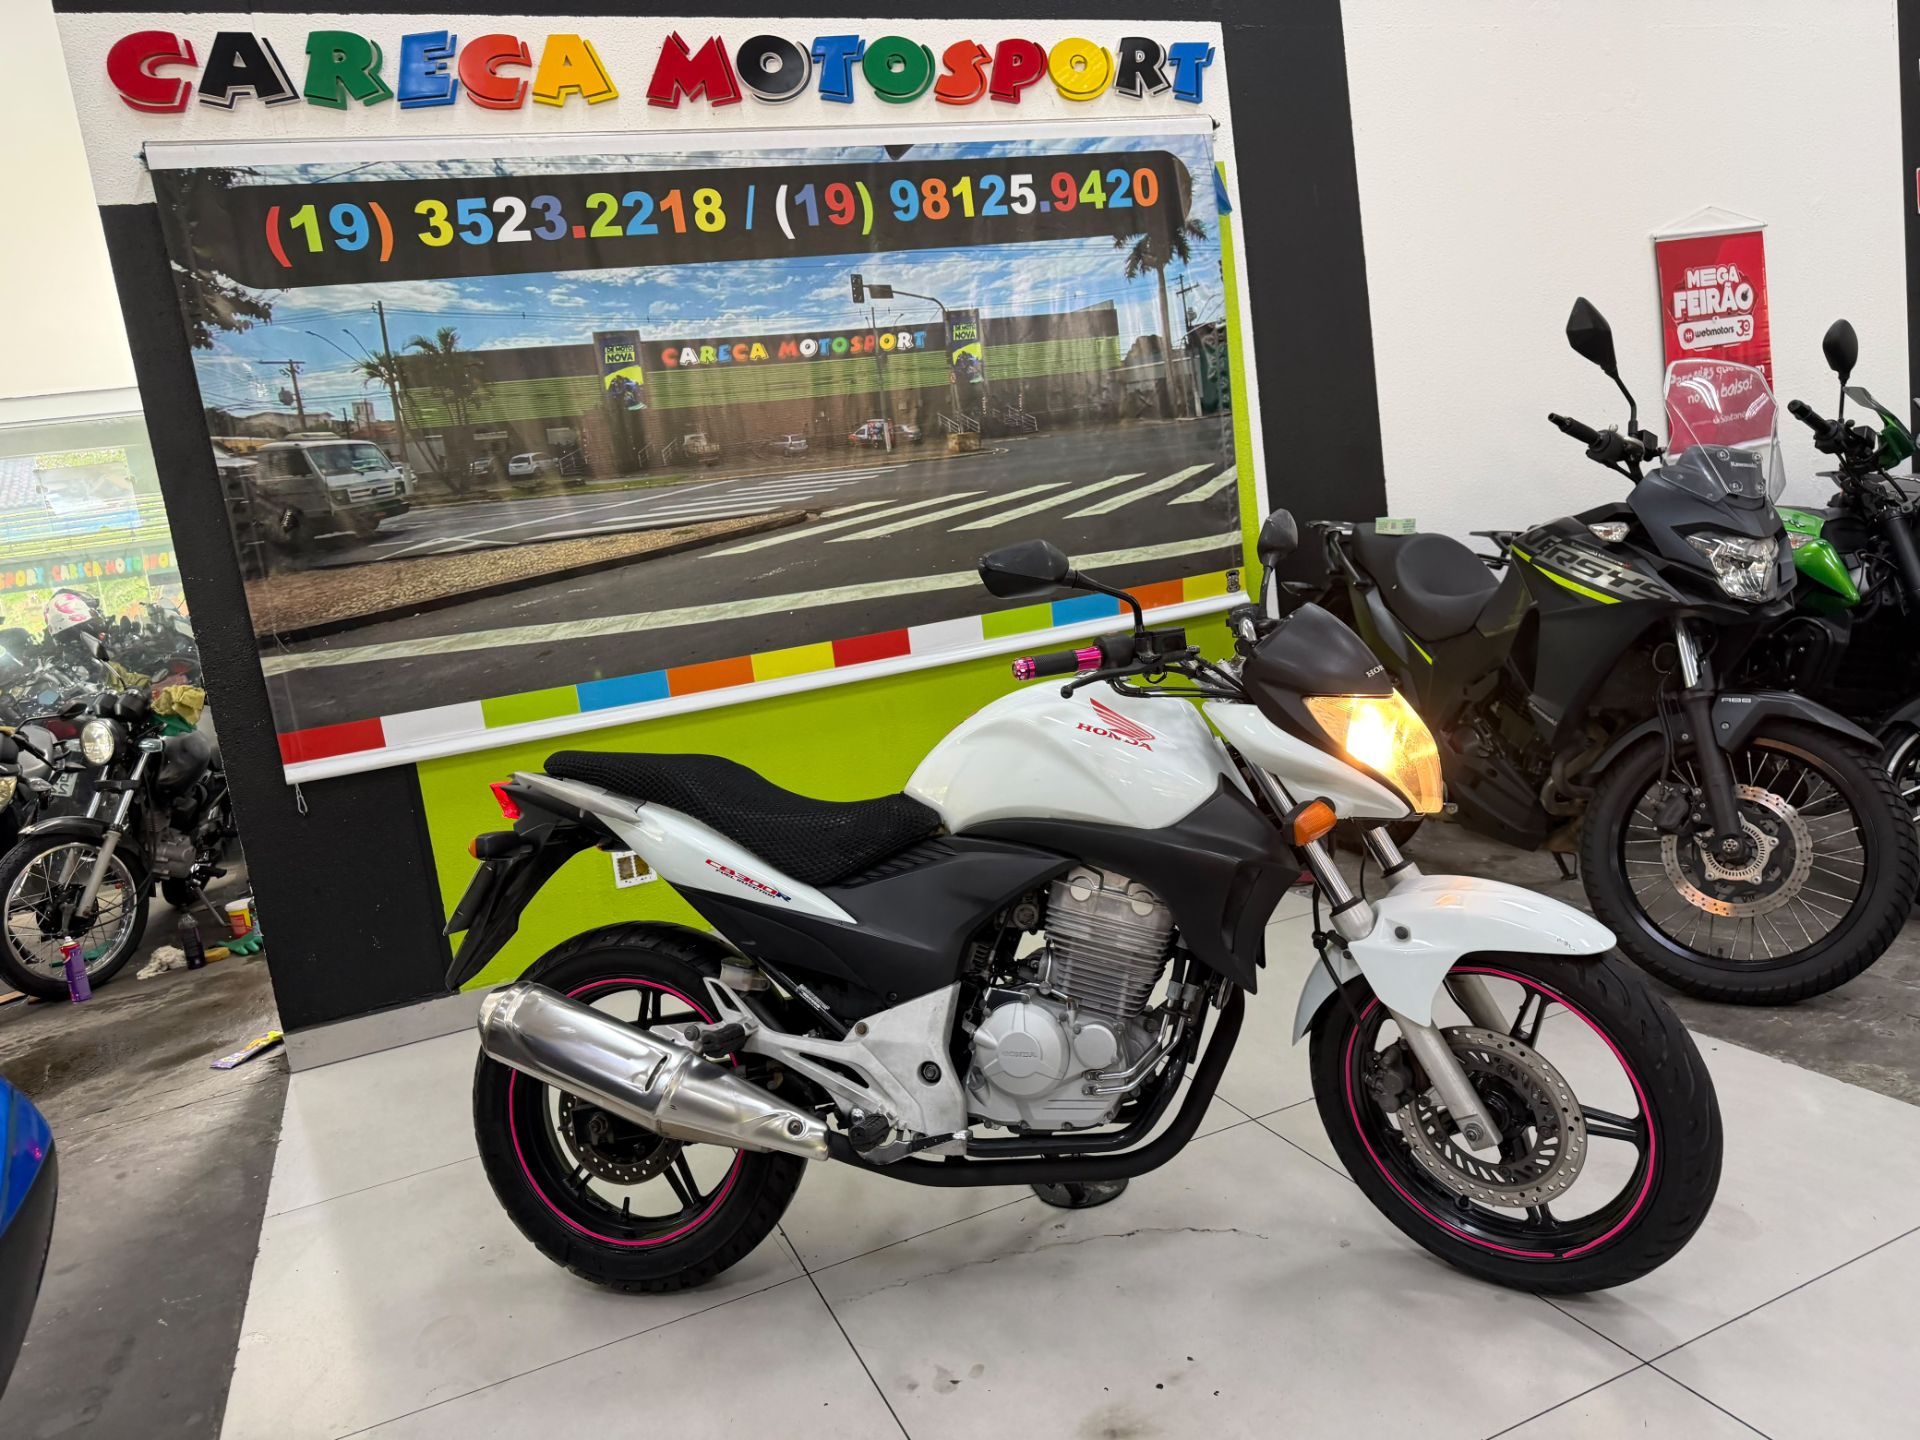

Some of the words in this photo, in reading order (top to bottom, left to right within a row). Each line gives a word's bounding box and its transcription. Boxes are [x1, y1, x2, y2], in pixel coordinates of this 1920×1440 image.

[106, 30, 618, 113] CARECA
[646, 30, 1216, 109] MOTOSPORT
[265, 201, 394, 268] (19)
[417, 187, 727, 247] 3523.2218
[776, 181, 873, 240] (19)
[889, 167, 1160, 223] 98125.9420
[1687, 265, 1739, 289] MEGA
[1673, 281, 1754, 319] FEIRÃO
[1695, 325, 1734, 338] webmotors
[606, 352, 634, 363] NOVA
[660, 342, 769, 368] CARECA
[778, 331, 927, 360] MOTOSPORT
[1720, 374, 1754, 397] bolso!
[1076, 722, 1154, 752] HONDA
